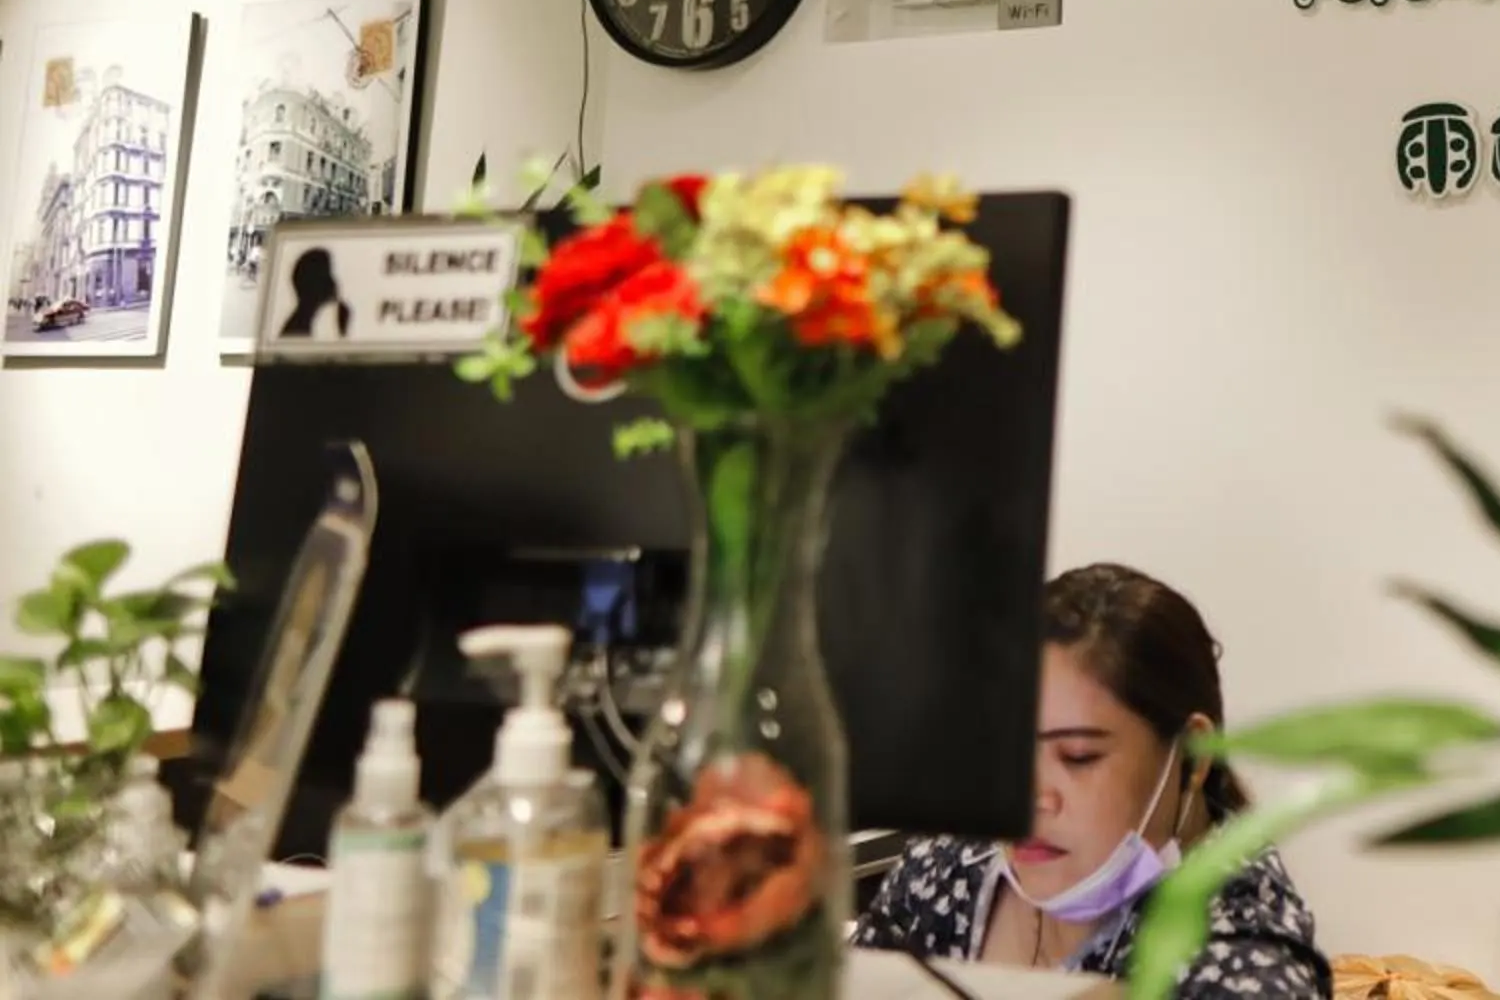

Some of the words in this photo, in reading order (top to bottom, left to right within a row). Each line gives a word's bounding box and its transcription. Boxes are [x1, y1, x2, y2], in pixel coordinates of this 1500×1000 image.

[649, 3, 668, 41] 7
[1008, 2, 1050, 20] Wi-Fi
[384, 249, 499, 275] SILENCE
